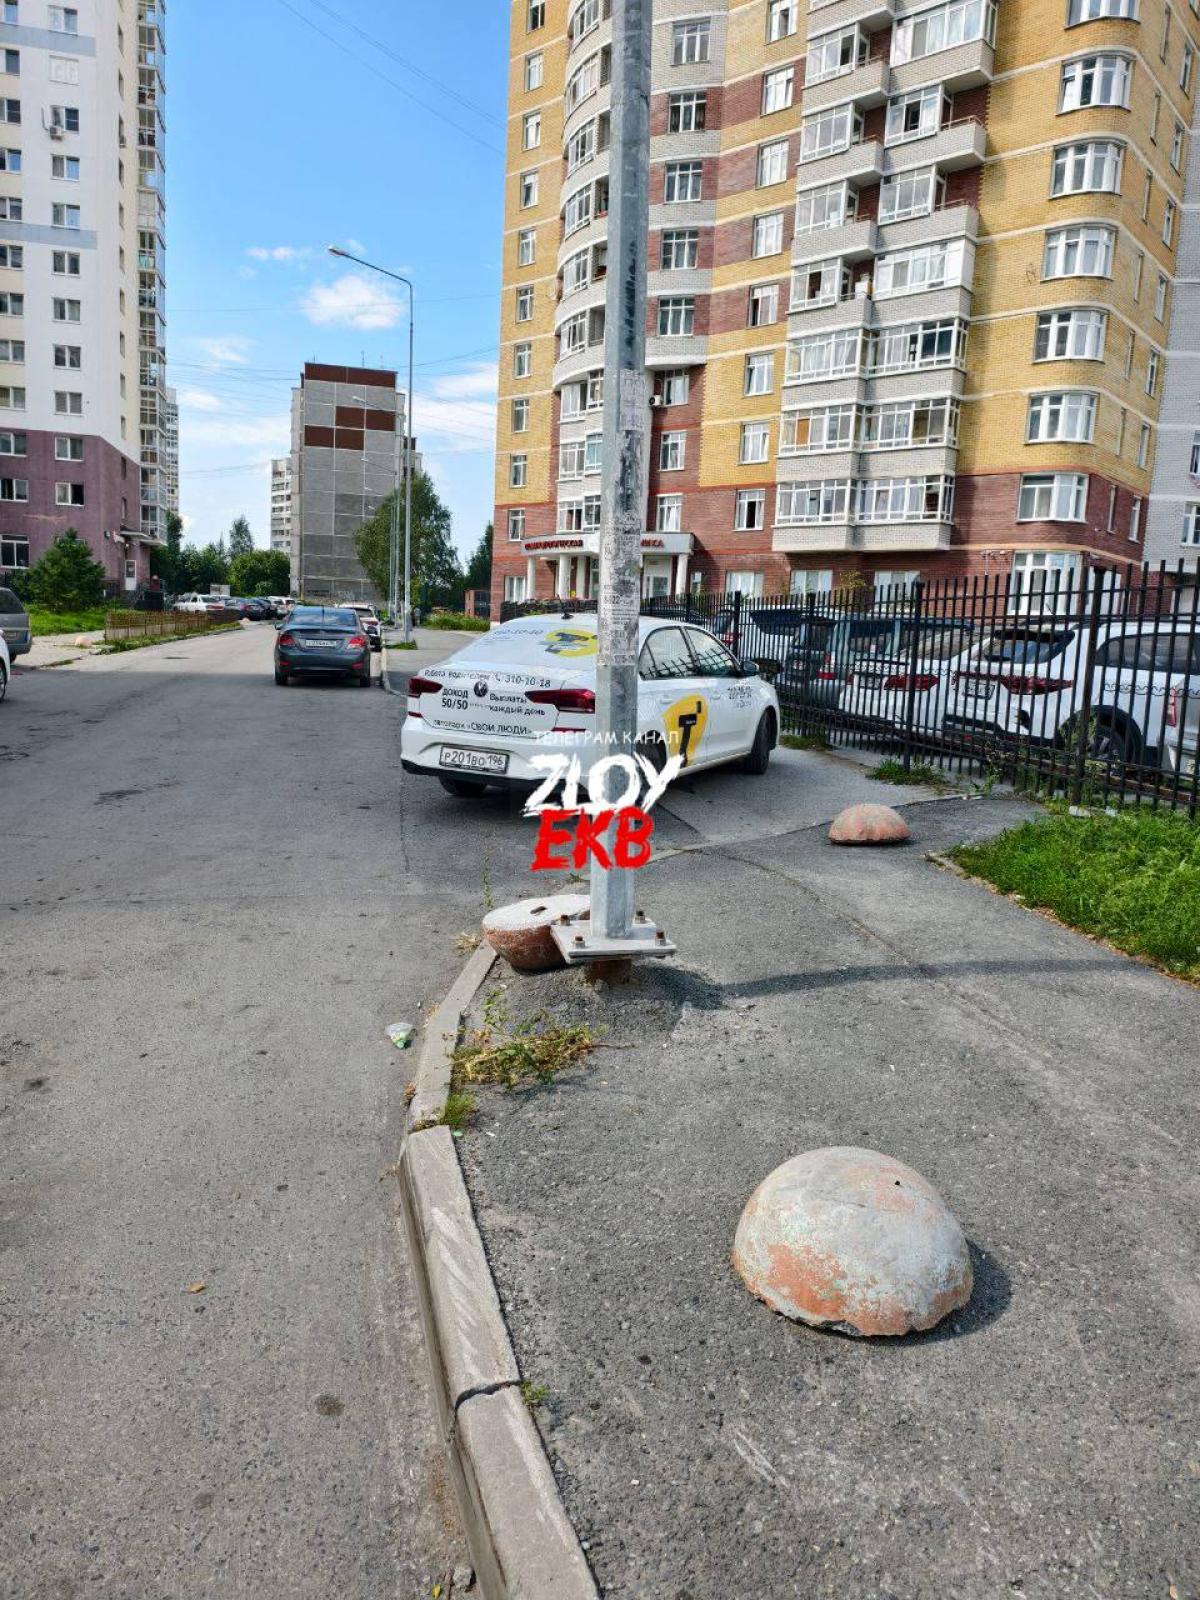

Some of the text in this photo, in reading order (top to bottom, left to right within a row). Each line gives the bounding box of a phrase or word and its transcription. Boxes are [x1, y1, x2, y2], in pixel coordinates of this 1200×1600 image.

[441, 698, 469, 710] 50/50
[489, 693, 528, 704] Выплаты
[489, 705, 523, 715] каждый
[524, 707, 546, 717] день
